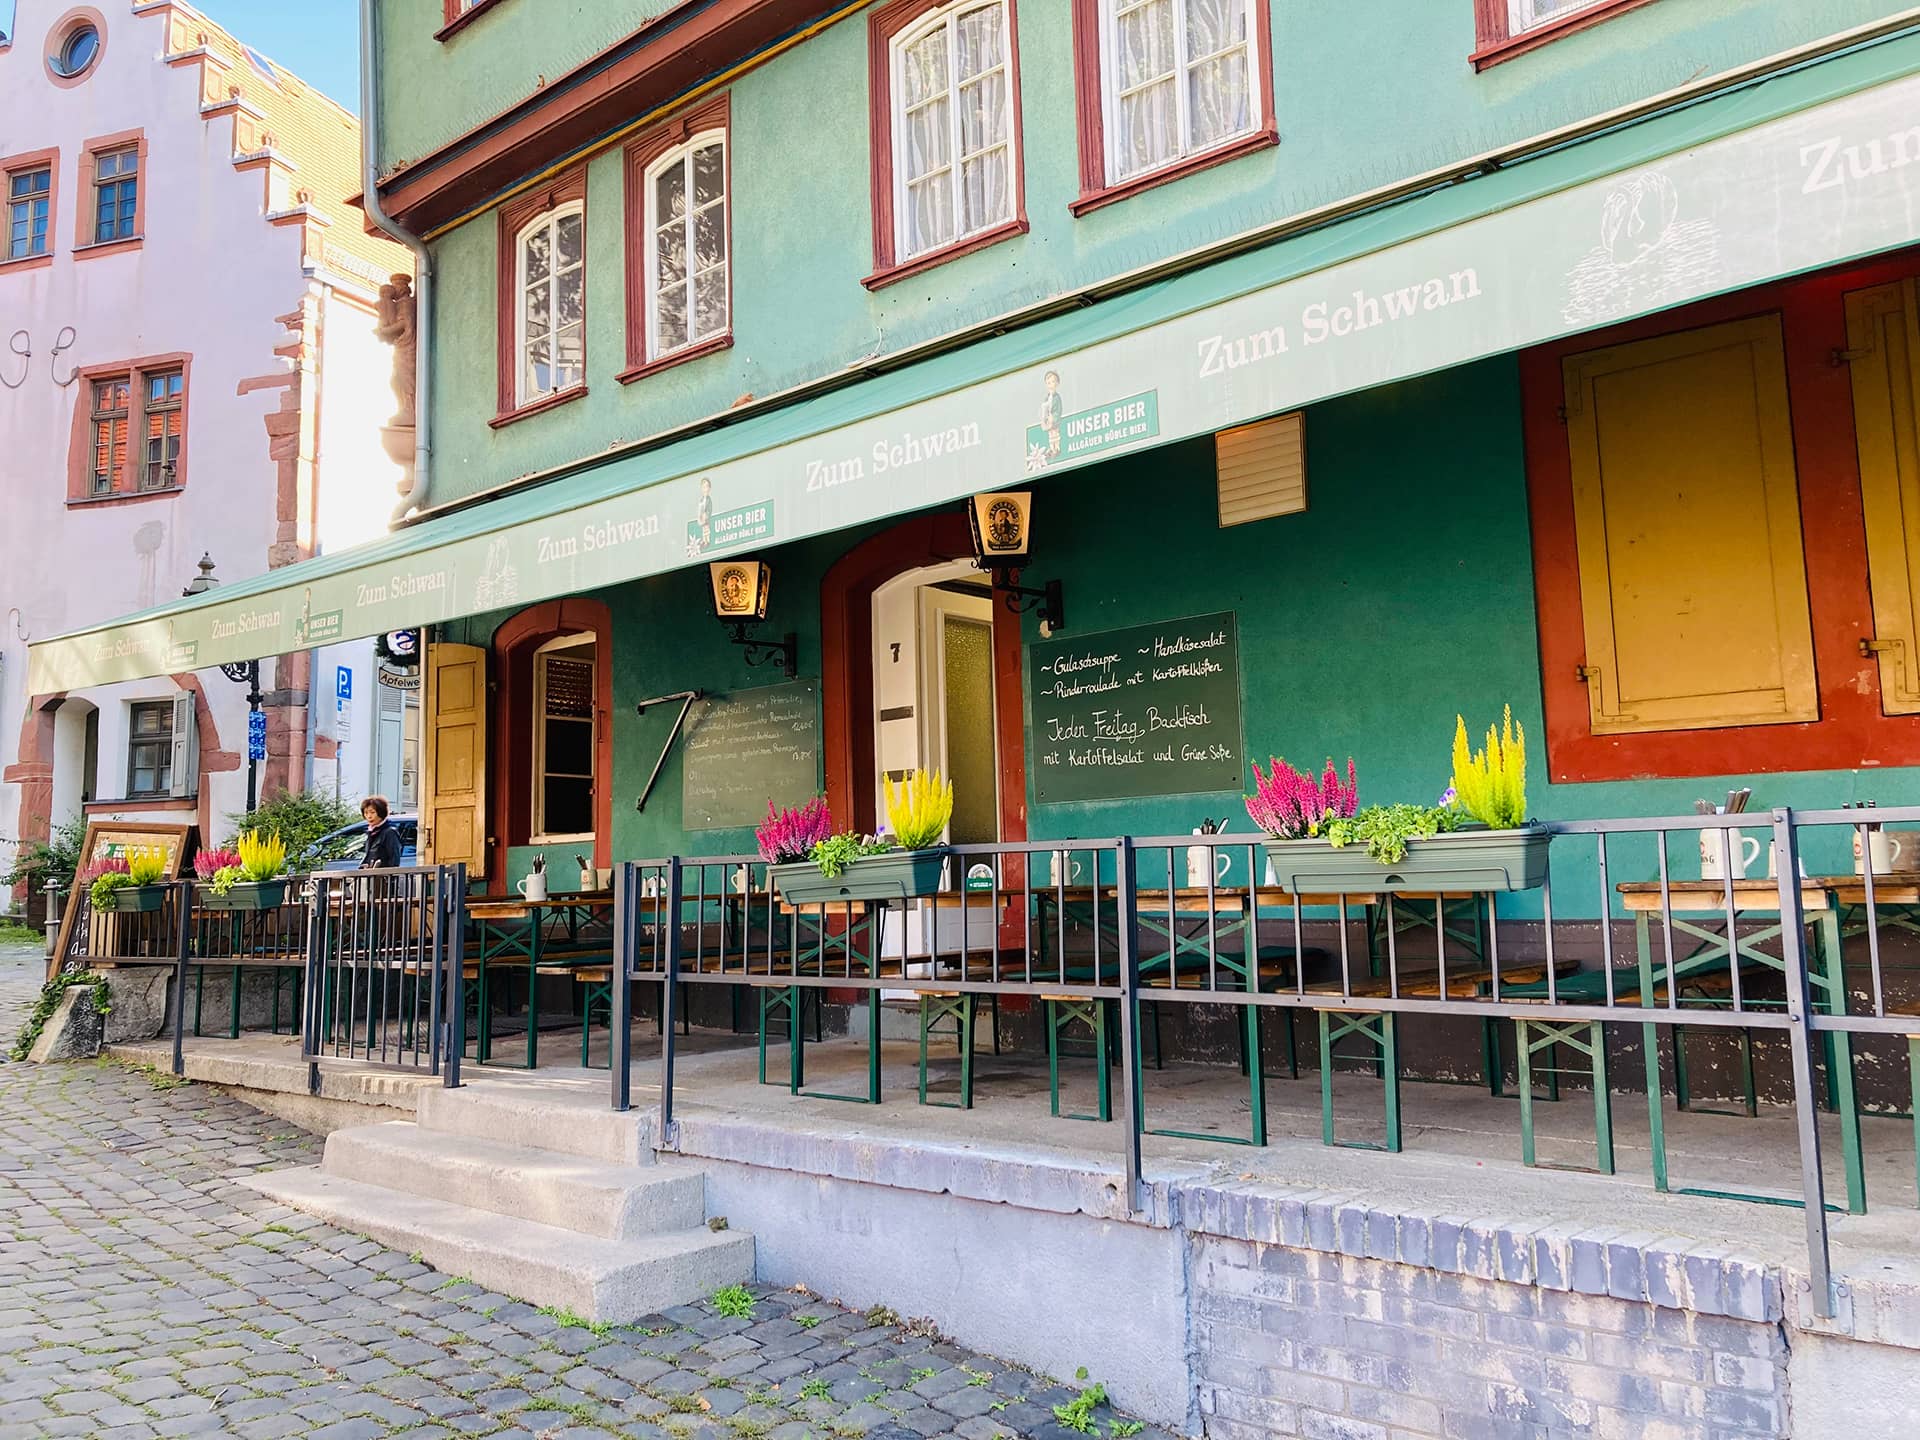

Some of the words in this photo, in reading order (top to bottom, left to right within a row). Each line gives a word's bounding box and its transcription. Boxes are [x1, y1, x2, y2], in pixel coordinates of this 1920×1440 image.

[1197, 325, 1289, 378] Zum
[1302, 266, 1482, 346] Schwan
[1066, 411, 1111, 438] UNSER
[1114, 401, 1146, 426] BIER
[1129, 422, 1147, 436] BIER
[805, 458, 865, 492] Zum
[872, 421, 982, 475] Schwan
[714, 512, 743, 533] UNSER
[745, 507, 766, 525] BIER
[538, 535, 577, 563] Zum
[583, 514, 660, 552] Schwan
[355, 583, 387, 607] Zum
[390, 571, 446, 599] Schwan
[211, 620, 236, 639] Zum
[238, 610, 281, 633] Schwan
[889, 642, 901, 664] 7
[1054, 672, 1122, 699] Rinderroulade
[1126, 670, 1145, 686] mit
[1046, 714, 1089, 742] Jeden
[1091, 708, 1146, 744] Freitag
[1146, 703, 1212, 732] Backfisch
[1043, 750, 1060, 766] mit
[1067, 747, 1145, 767] Kartoffelsalat
[1152, 744, 1175, 762] und
